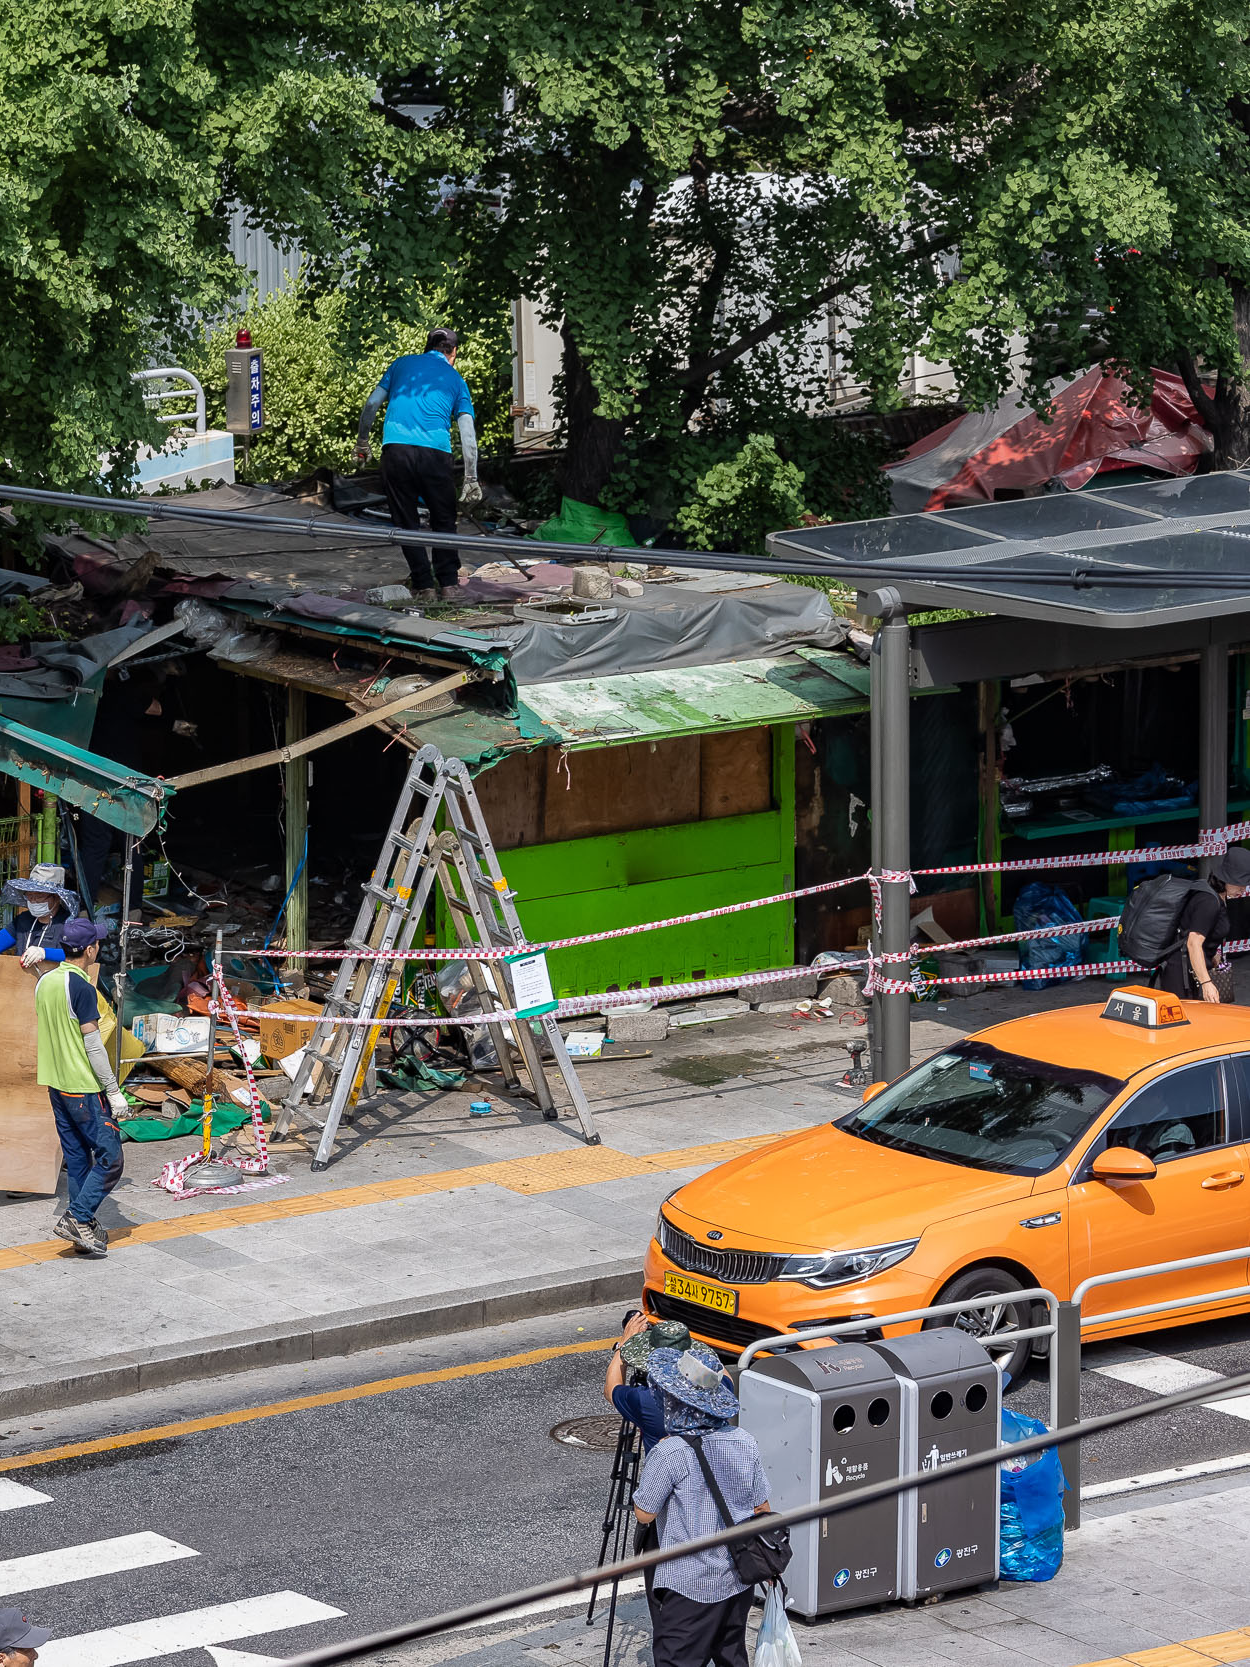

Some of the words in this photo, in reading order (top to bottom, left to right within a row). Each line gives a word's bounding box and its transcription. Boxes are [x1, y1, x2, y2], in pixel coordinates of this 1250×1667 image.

[250, 359, 260, 424] 출차주의
[1160, 850, 1185, 858] DANGER
[1114, 1002, 1142, 1021] 서울
[708, 1231, 721, 1240] KIA
[701, 1286, 730, 1309] 9757
[939, 1449, 968, 1462] 일반쓰레기
[846, 1463, 869, 1474] 재활용품
[845, 1473, 866, 1482] Recycle
[956, 1544, 979, 1558] 광진구
[854, 1567, 878, 1580] 광진구
